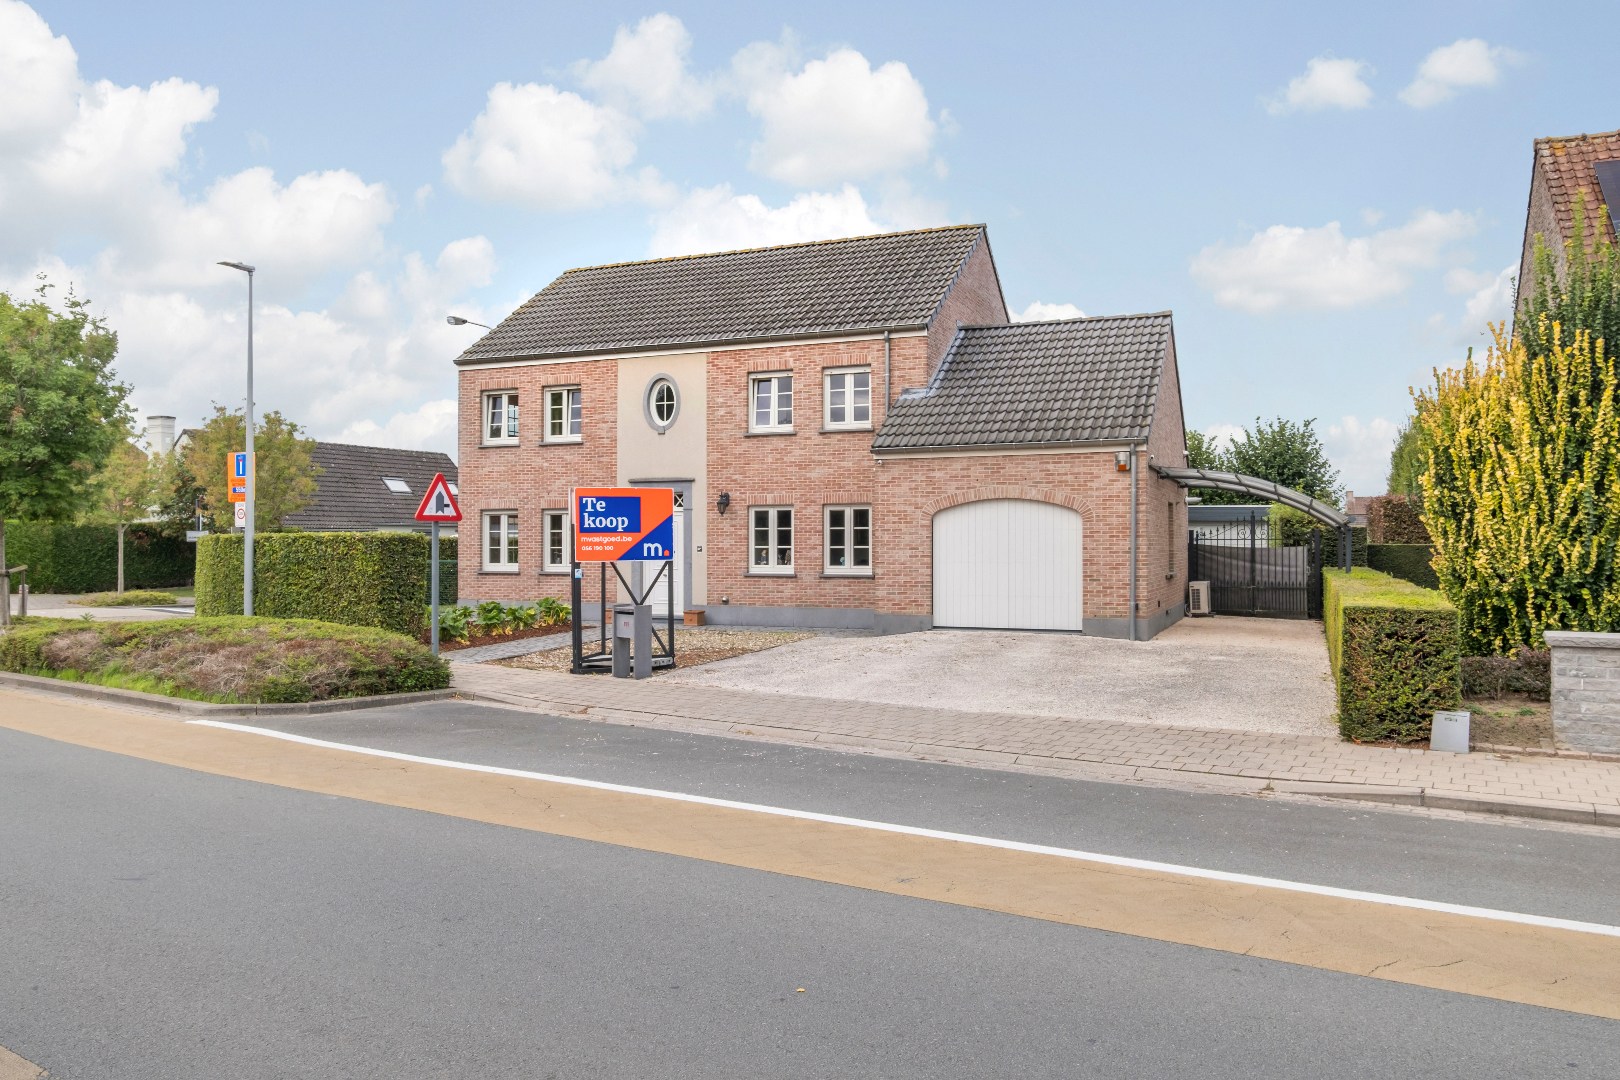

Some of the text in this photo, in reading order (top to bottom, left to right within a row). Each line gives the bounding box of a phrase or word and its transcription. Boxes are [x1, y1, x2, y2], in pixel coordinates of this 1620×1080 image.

[582, 497, 606, 512] Te
[583, 513, 629, 532] koop
[580, 535, 633, 544] mvastgoed.be
